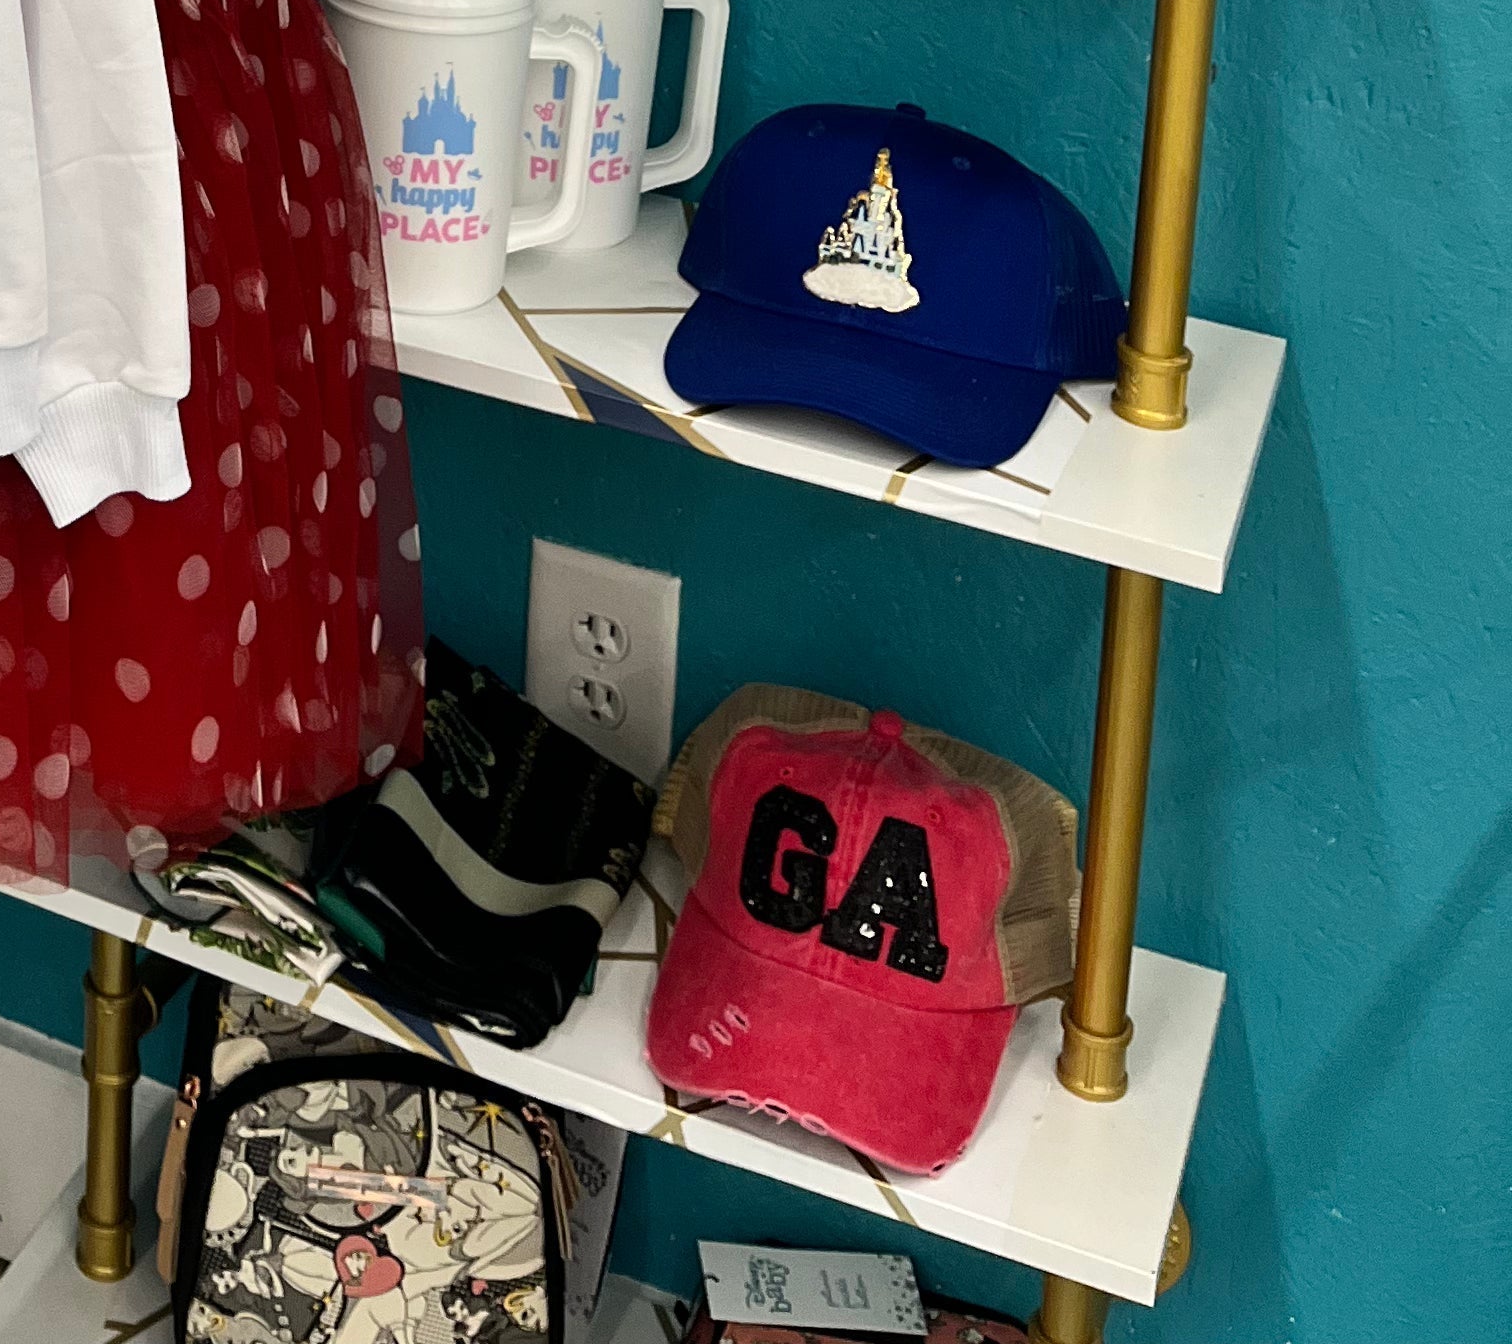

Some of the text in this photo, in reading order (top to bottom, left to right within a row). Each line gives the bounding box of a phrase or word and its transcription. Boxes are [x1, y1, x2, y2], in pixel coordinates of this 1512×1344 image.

[540, 124, 620, 158] hpy
[409, 158, 465, 185] MY
[530, 156, 623, 184] PLCE
[390, 177, 476, 215] happy
[381, 212, 480, 243] PLACE
[739, 783, 949, 983] GA
[765, 1259, 792, 1314] baby
